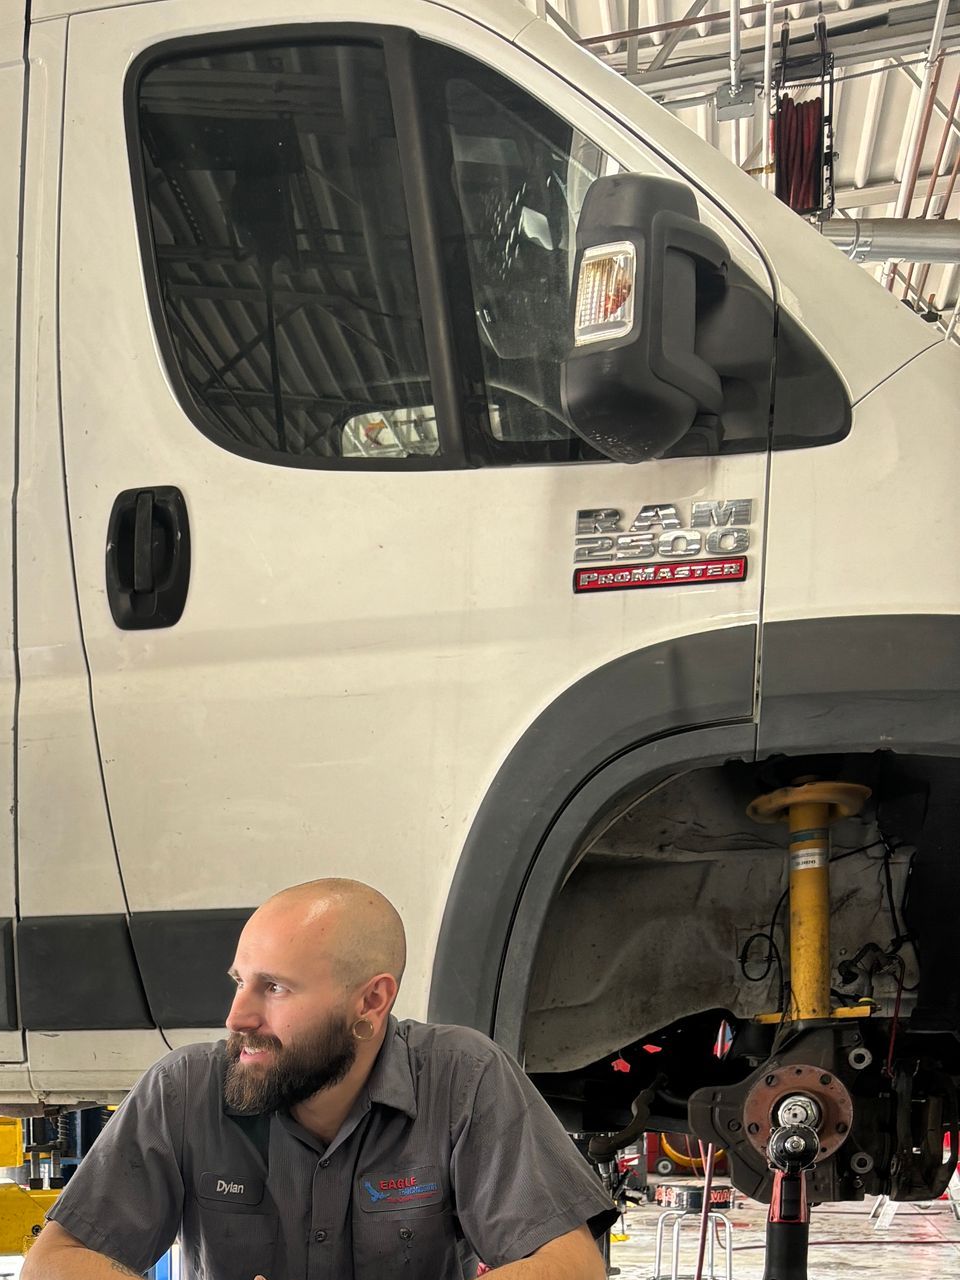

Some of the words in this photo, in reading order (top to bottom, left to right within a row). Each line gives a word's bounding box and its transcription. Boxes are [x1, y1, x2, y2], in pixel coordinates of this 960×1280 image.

[575, 498, 753, 535] RAM
[573, 527, 751, 563] 2500
[215, 1180, 244, 1195] Dylan
[379, 1176, 417, 1190] EAGLE
